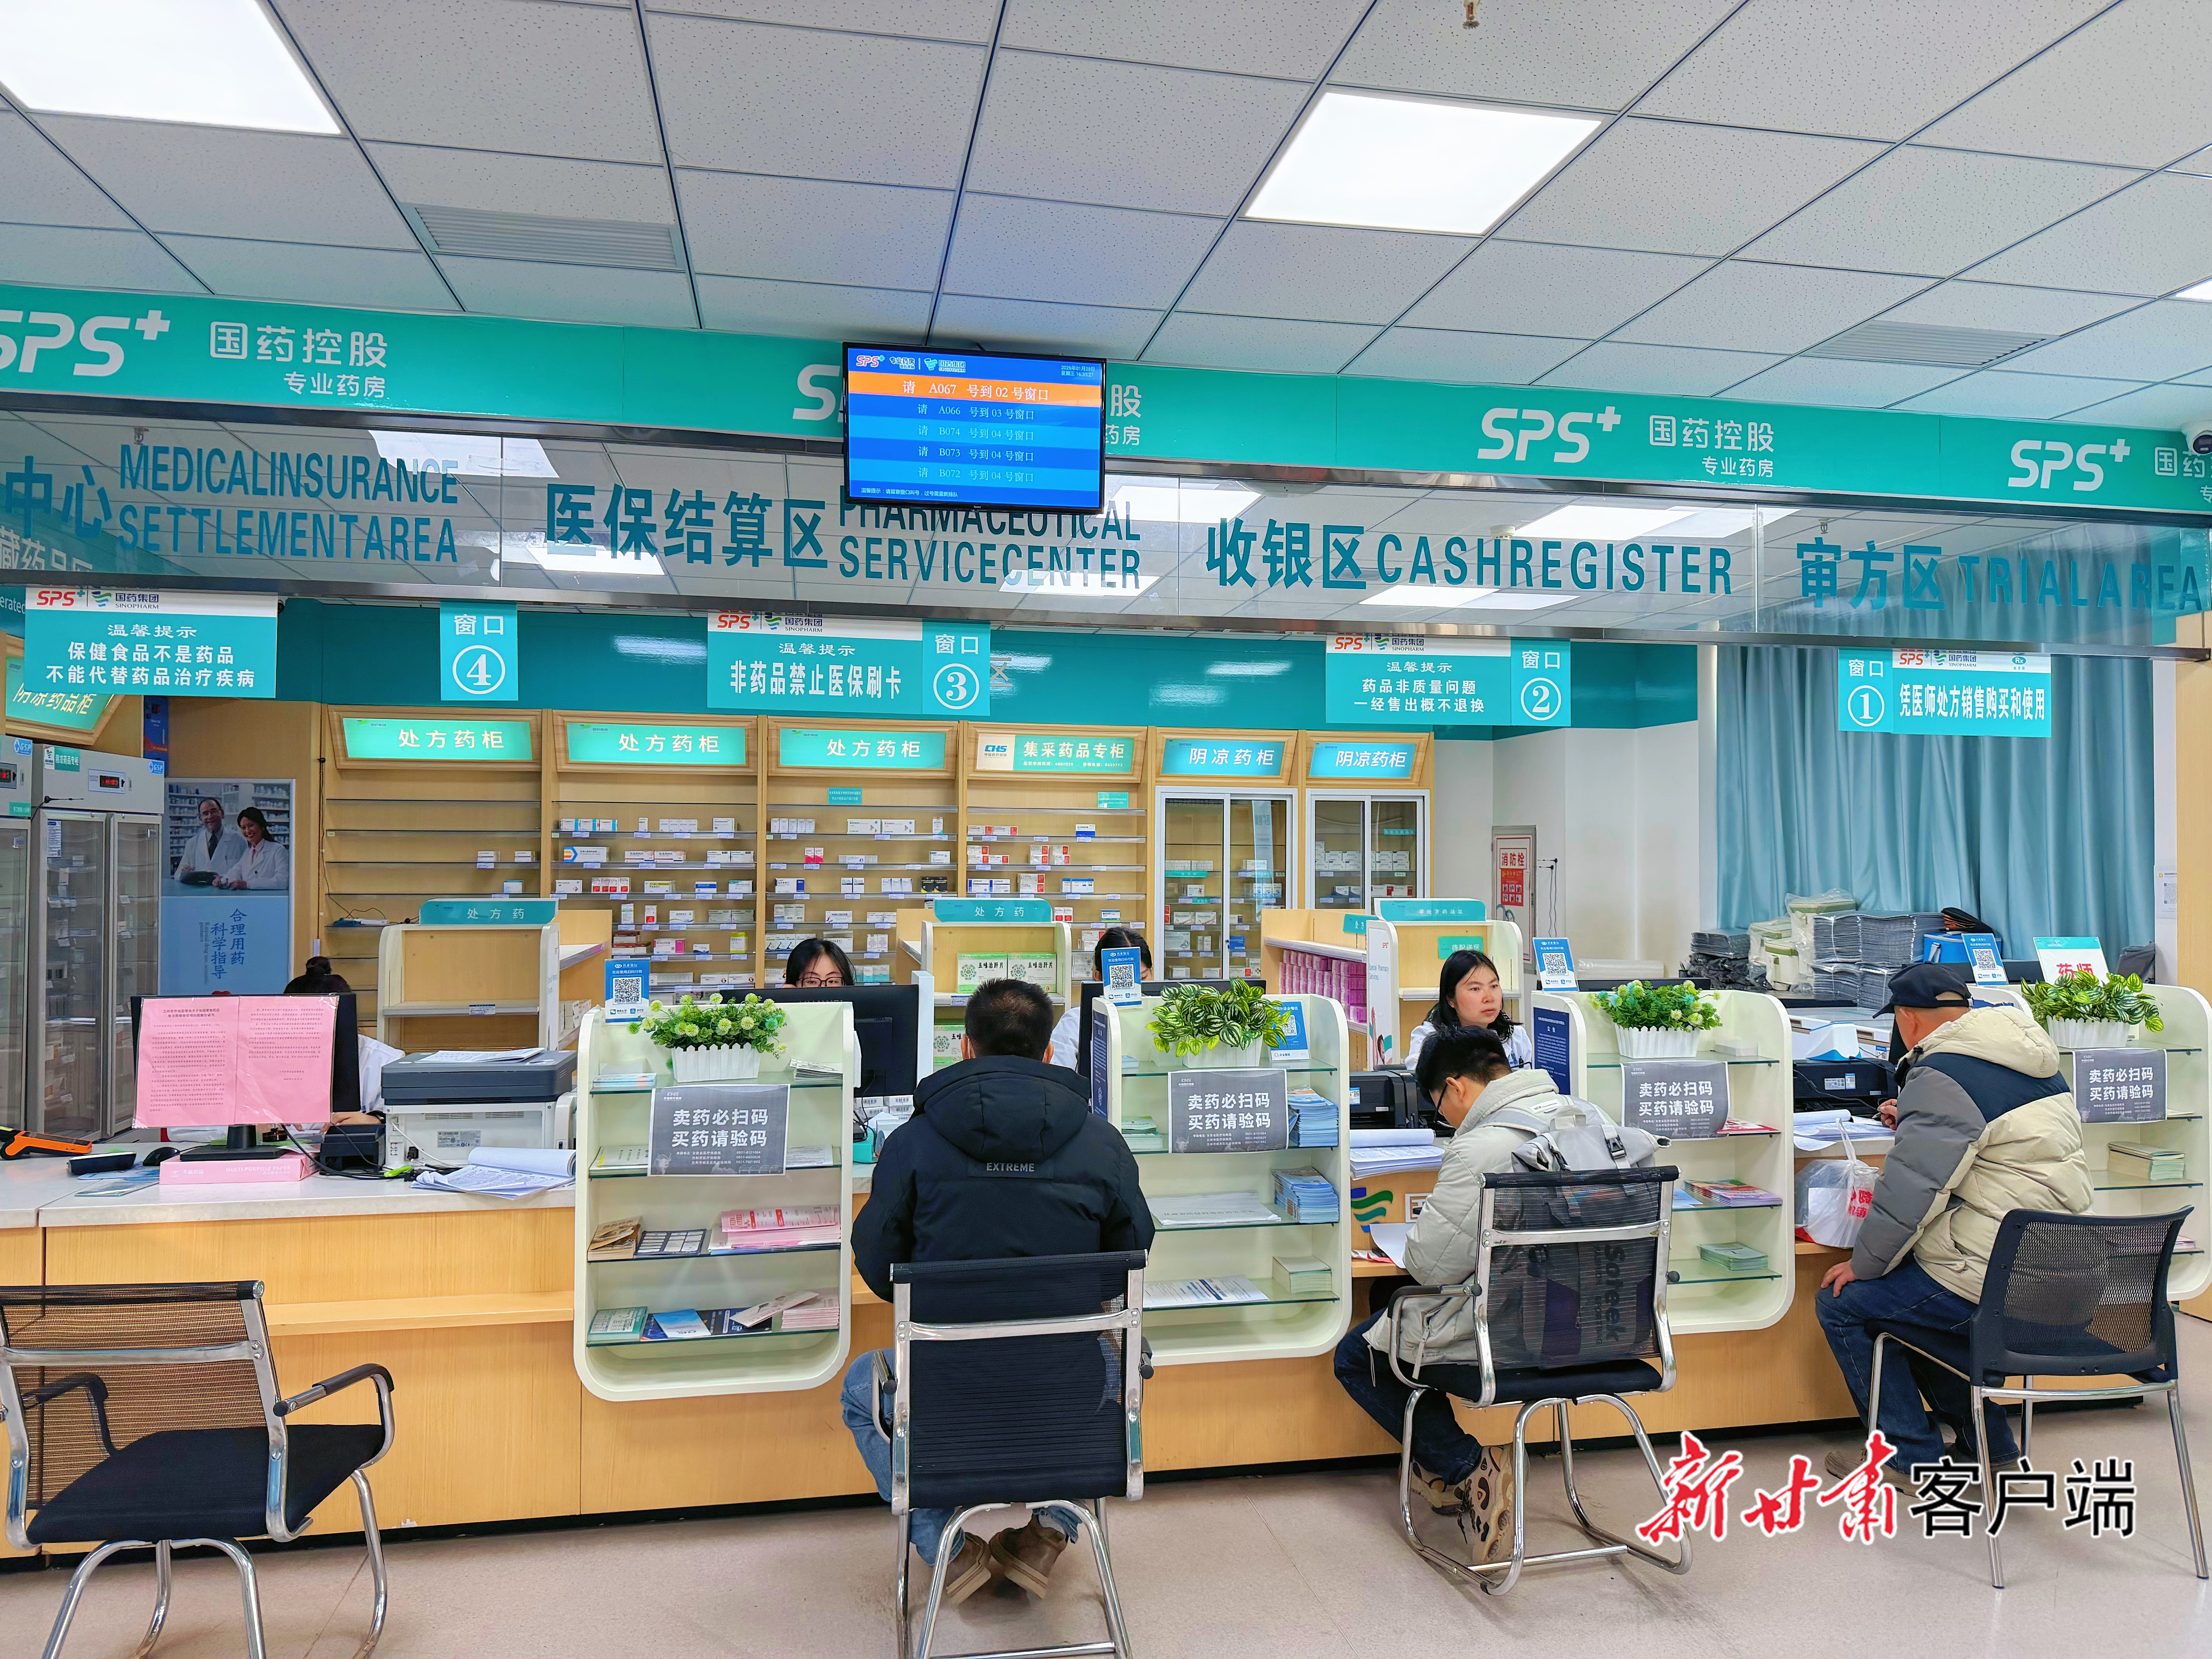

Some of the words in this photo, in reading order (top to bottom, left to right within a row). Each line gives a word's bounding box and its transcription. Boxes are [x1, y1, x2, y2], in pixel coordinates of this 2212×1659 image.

[210, 321, 388, 369] 国药控股
[283, 371, 386, 398] 专业药房
[903, 381, 915, 394] 请
[929, 384, 957, 394] A067
[967, 385, 992, 398] 号到
[996, 388, 1008, 398] 02
[1012, 388, 1048, 401] 号窗口
[918, 404, 928, 414] 请
[938, 406, 960, 415] A066
[969, 407, 989, 418] 号到
[991, 409, 1002, 417] 03
[1005, 409, 1034, 420] 号窗口
[918, 425, 928, 436] 请
[938, 427, 960, 436] B074
[969, 428, 989, 439] 号到
[991, 430, 1002, 438] 04
[1005, 430, 1034, 441] 号窗口
[1649, 415, 1774, 453] 国药控股
[918, 446, 928, 457] 请
[938, 448, 960, 457] B073
[969, 449, 989, 460] 号到
[991, 451, 1002, 459] 04
[1005, 451, 1034, 462] 号窗口
[2154, 447, 2212, 478] 国药
[119, 444, 459, 503] MEDICALINSURANCE
[918, 467, 928, 478] 请
[938, 469, 960, 478] B072
[969, 470, 989, 481] 号到
[991, 472, 1002, 480] 04
[1005, 472, 1034, 483] 号窗口
[1702, 456, 1774, 479] 专业药房
[5, 455, 112, 541] 中心
[119, 504, 458, 562] SETTLEMENTAREA
[547, 483, 828, 569] 医保结算区
[840, 536, 1140, 589] SERVICECENTER
[1206, 517, 1367, 590] 收银区
[1377, 533, 1732, 595] CASHREGISTER
[1796, 537, 1945, 610] 审方区
[115, 592, 159, 603] 国药集团
[107, 624, 197, 638] 温馨提示
[454, 614, 504, 635] 窗口
[785, 617, 823, 627] 国药集团
[778, 642, 856, 656] 温馨提示
[934, 634, 979, 655] 窗口
[1392, 638, 1424, 647] 国药集团
[68, 641, 234, 665] 保健食品不是药品
[1522, 651, 1561, 670] 窗口
[1386, 661, 1453, 673] 温馨提示
[1848, 659, 1884, 678] 窗口
[46, 665, 254, 688] 不能代替药品治疗疾病
[730, 659, 902, 699] 非药品禁止医保刷卡
[1362, 678, 1476, 694] 药品非质量问题
[1354, 697, 1485, 713] 一经售出概不退换
[1899, 683, 2045, 721] 凭医师处方销售购买和使用
[20, 742, 31, 752] GSP
[398, 728, 505, 749] 处方药柜
[618, 733, 720, 754] 处方药柜
[826, 738, 921, 758] 处方药柜
[1024, 740, 1125, 759] 集采药品专柜
[1188, 748, 1275, 766] 阴凉药柜
[1335, 750, 1408, 768] 阴凉药柜
[1502, 852, 1525, 866] 消防栓
[467, 908, 525, 919] 处方药
[974, 907, 1024, 917] 处方药
[230, 908, 247, 965] 合理用药
[210, 922, 228, 979] 科学指导
[2089, 1067, 2154, 1084] 卖药必扫码
[1639, 1081, 1713, 1097] 卖药必扫码
[2090, 1084, 2154, 1101] 买药请验码
[1188, 1092, 1270, 1110] 卖药必扫码
[1638, 1100, 1714, 1116] 买药请验码
[673, 1109, 768, 1127] 卖药必扫码
[1188, 1113, 1271, 1130] 买药请验码
[672, 1130, 767, 1147] 买药请验码
[986, 1162, 1035, 1172] EXTREME
